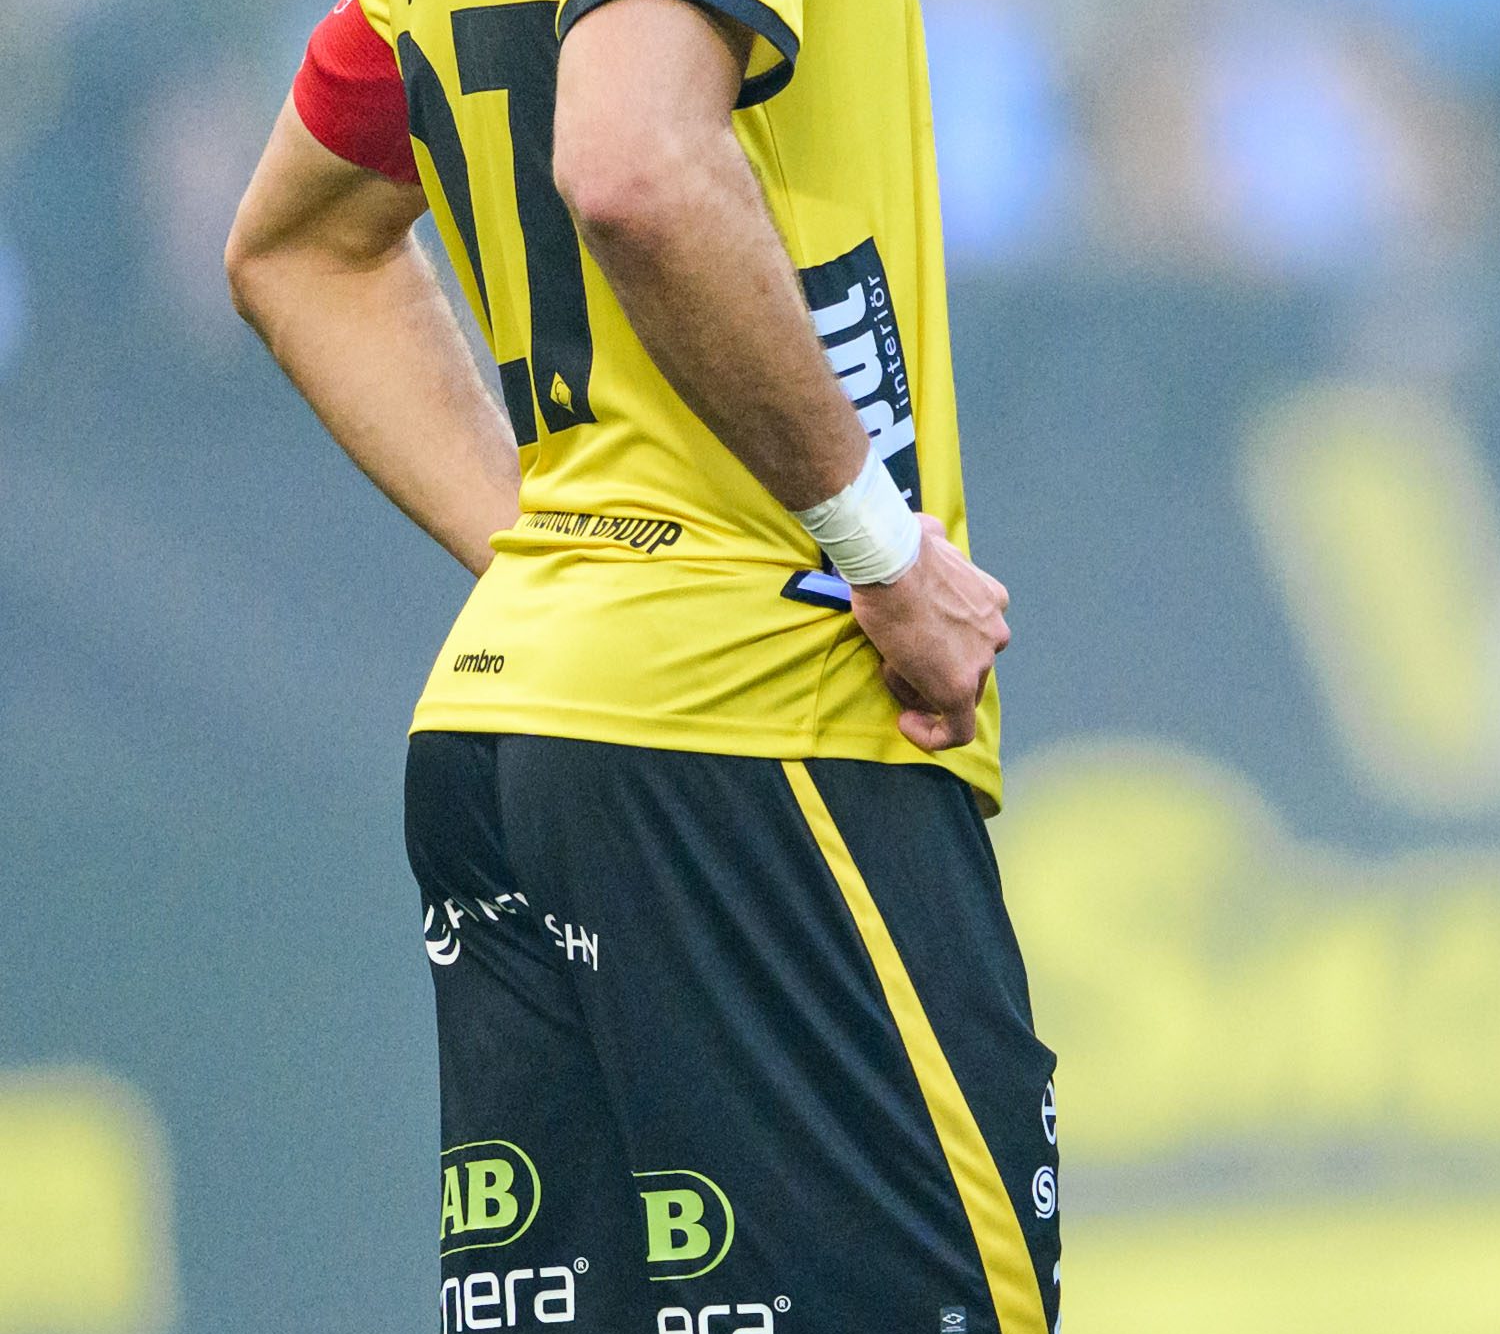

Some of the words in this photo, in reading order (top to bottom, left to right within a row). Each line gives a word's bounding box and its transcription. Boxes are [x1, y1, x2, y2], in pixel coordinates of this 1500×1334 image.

[867, 275, 910, 410] interiör
[453, 649, 505, 674] umbro
[440, 1158, 519, 1241] AB
